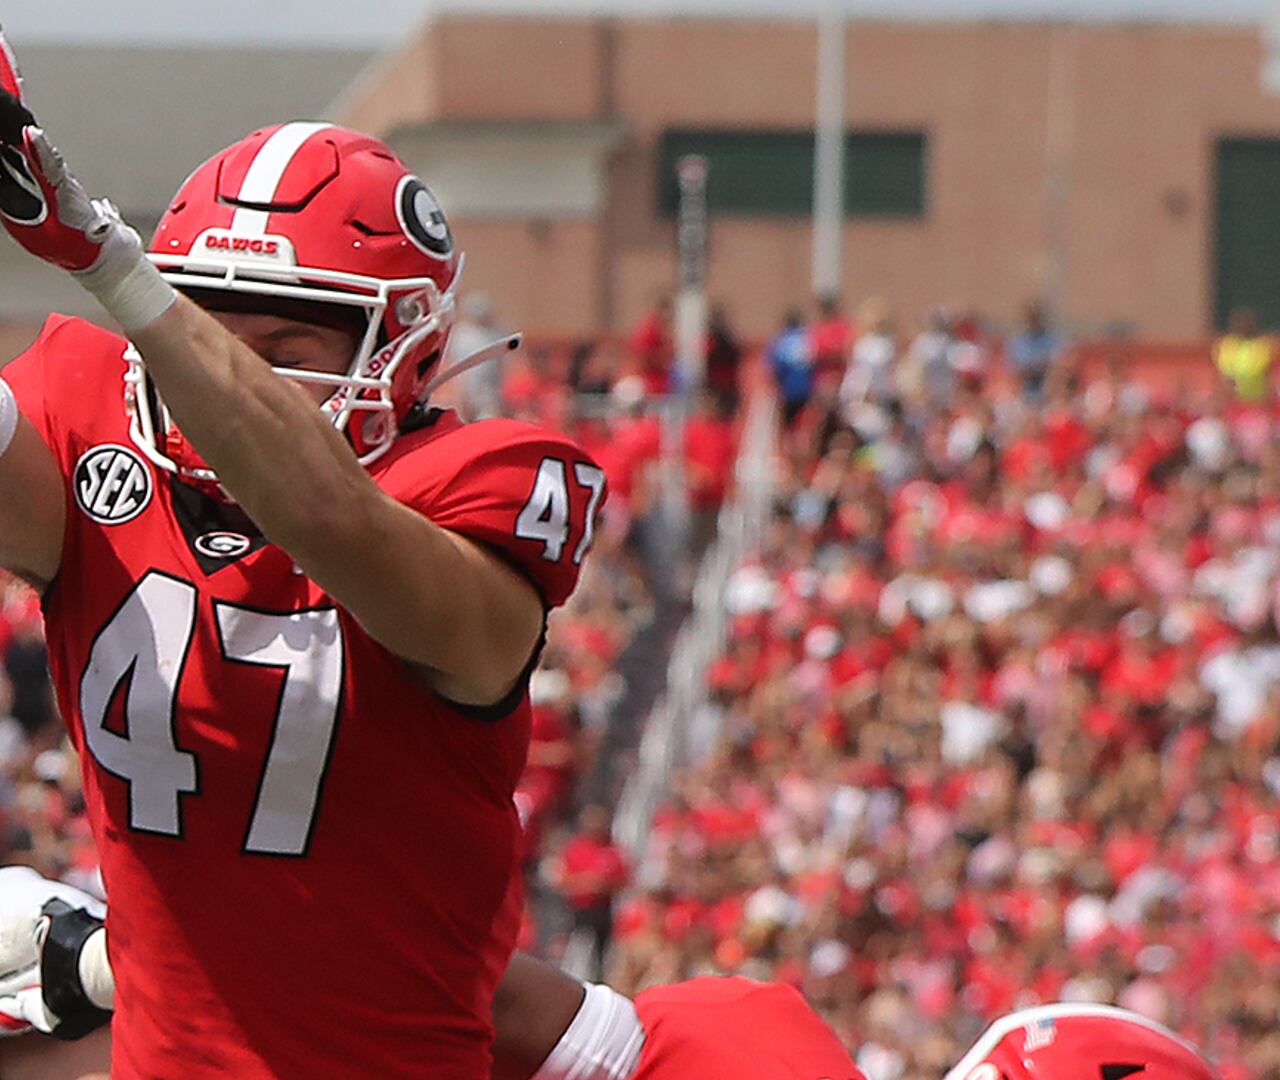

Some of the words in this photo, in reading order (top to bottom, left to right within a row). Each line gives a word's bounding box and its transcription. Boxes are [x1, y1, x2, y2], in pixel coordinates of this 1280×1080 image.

[204, 234, 279, 256] DAWGS
[78, 449, 148, 520] SEC
[514, 456, 607, 564] 47
[80, 567, 344, 856] 47
